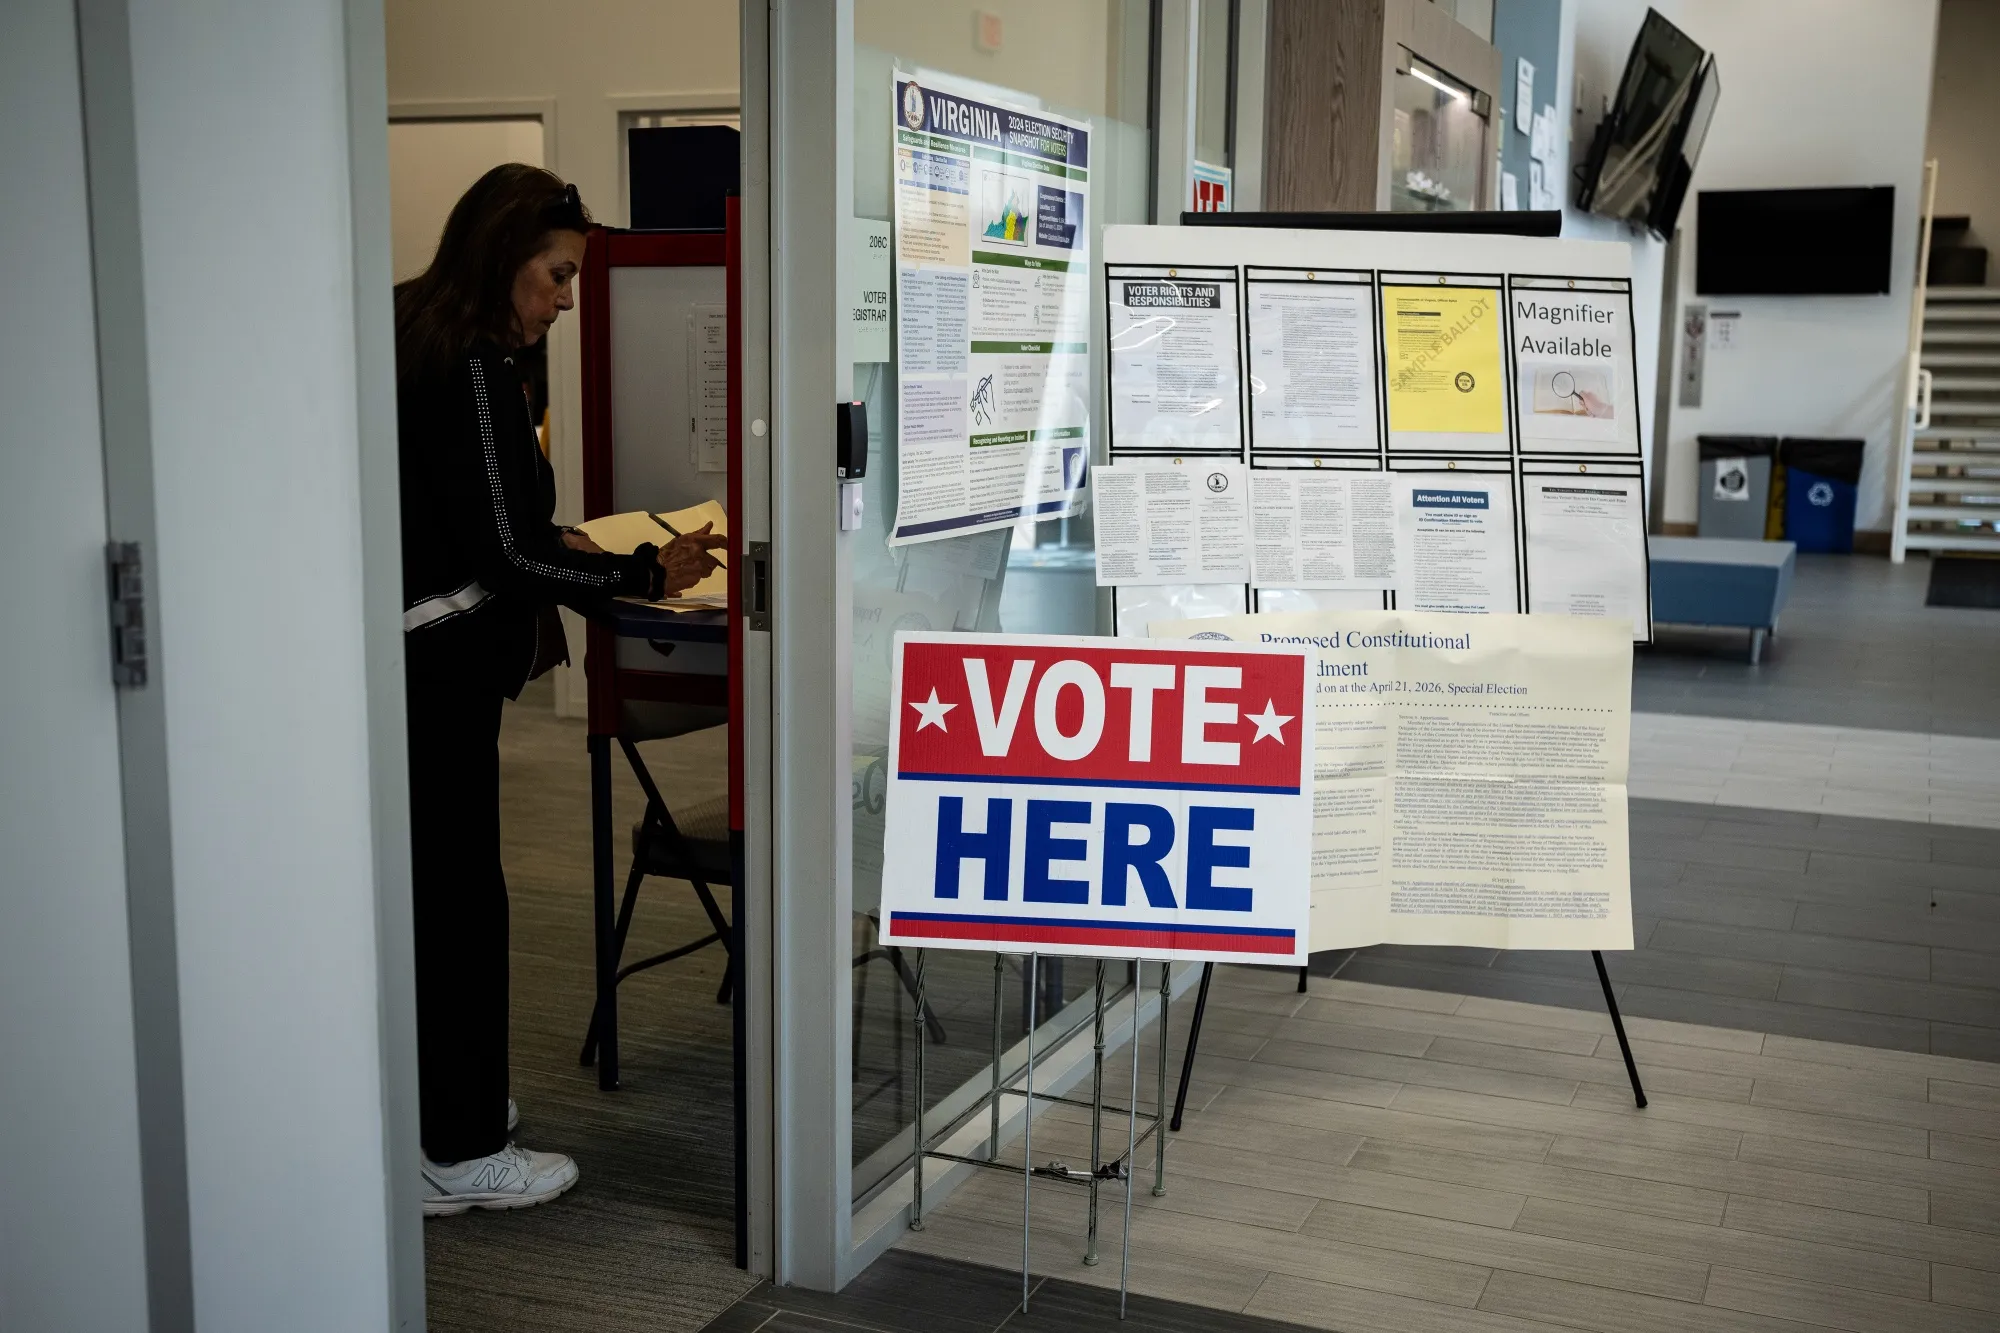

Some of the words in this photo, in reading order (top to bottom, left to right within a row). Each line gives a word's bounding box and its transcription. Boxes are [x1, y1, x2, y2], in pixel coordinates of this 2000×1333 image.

[930, 96, 1001, 142] VIRGINIA
[1008, 116, 1024, 130] 2024
[1025, 120, 1051, 137] ELECTION
[1052, 127, 1074, 144] SECURITY
[902, 134, 922, 144] Safeguards
[930, 140, 949, 150] Resilience
[1010, 132, 1039, 150] SNAPSHOT
[1040, 140, 1049, 151] FOR
[1050, 142, 1067, 156] VOTERS
[869, 236, 887, 248] 206C
[864, 291, 886, 304] VOTER
[1128, 286, 1158, 295] VOTER
[1160, 286, 1193, 296] RIGHTS
[1195, 288, 1215, 297] AND
[1129, 296, 1210, 307] RESPONSIBILITIES
[853, 308, 886, 321] EGISTRAR
[1517, 302, 1614, 325] Magnifier
[1390, 340, 1444, 392] SAMPLE
[1440, 297, 1490, 346] BALLOT
[1520, 335, 1612, 358] Available
[973, 437, 991, 446] Recognizing
[1346, 630, 1471, 650] Constitutional
[1317, 660, 1368, 676] dment
[1339, 684, 1348, 692] at
[1351, 683, 1366, 692] the
[1370, 681, 1393, 694] April
[1395, 682, 1411, 694] 21,
[1415, 683, 1443, 695] 2026,
[1448, 683, 1483, 696] Special
[1486, 684, 1527, 695] Election
[962, 657, 1242, 766] VOTE
[934, 796, 1255, 912] HERE
[472, 1163, 510, 1190] N
